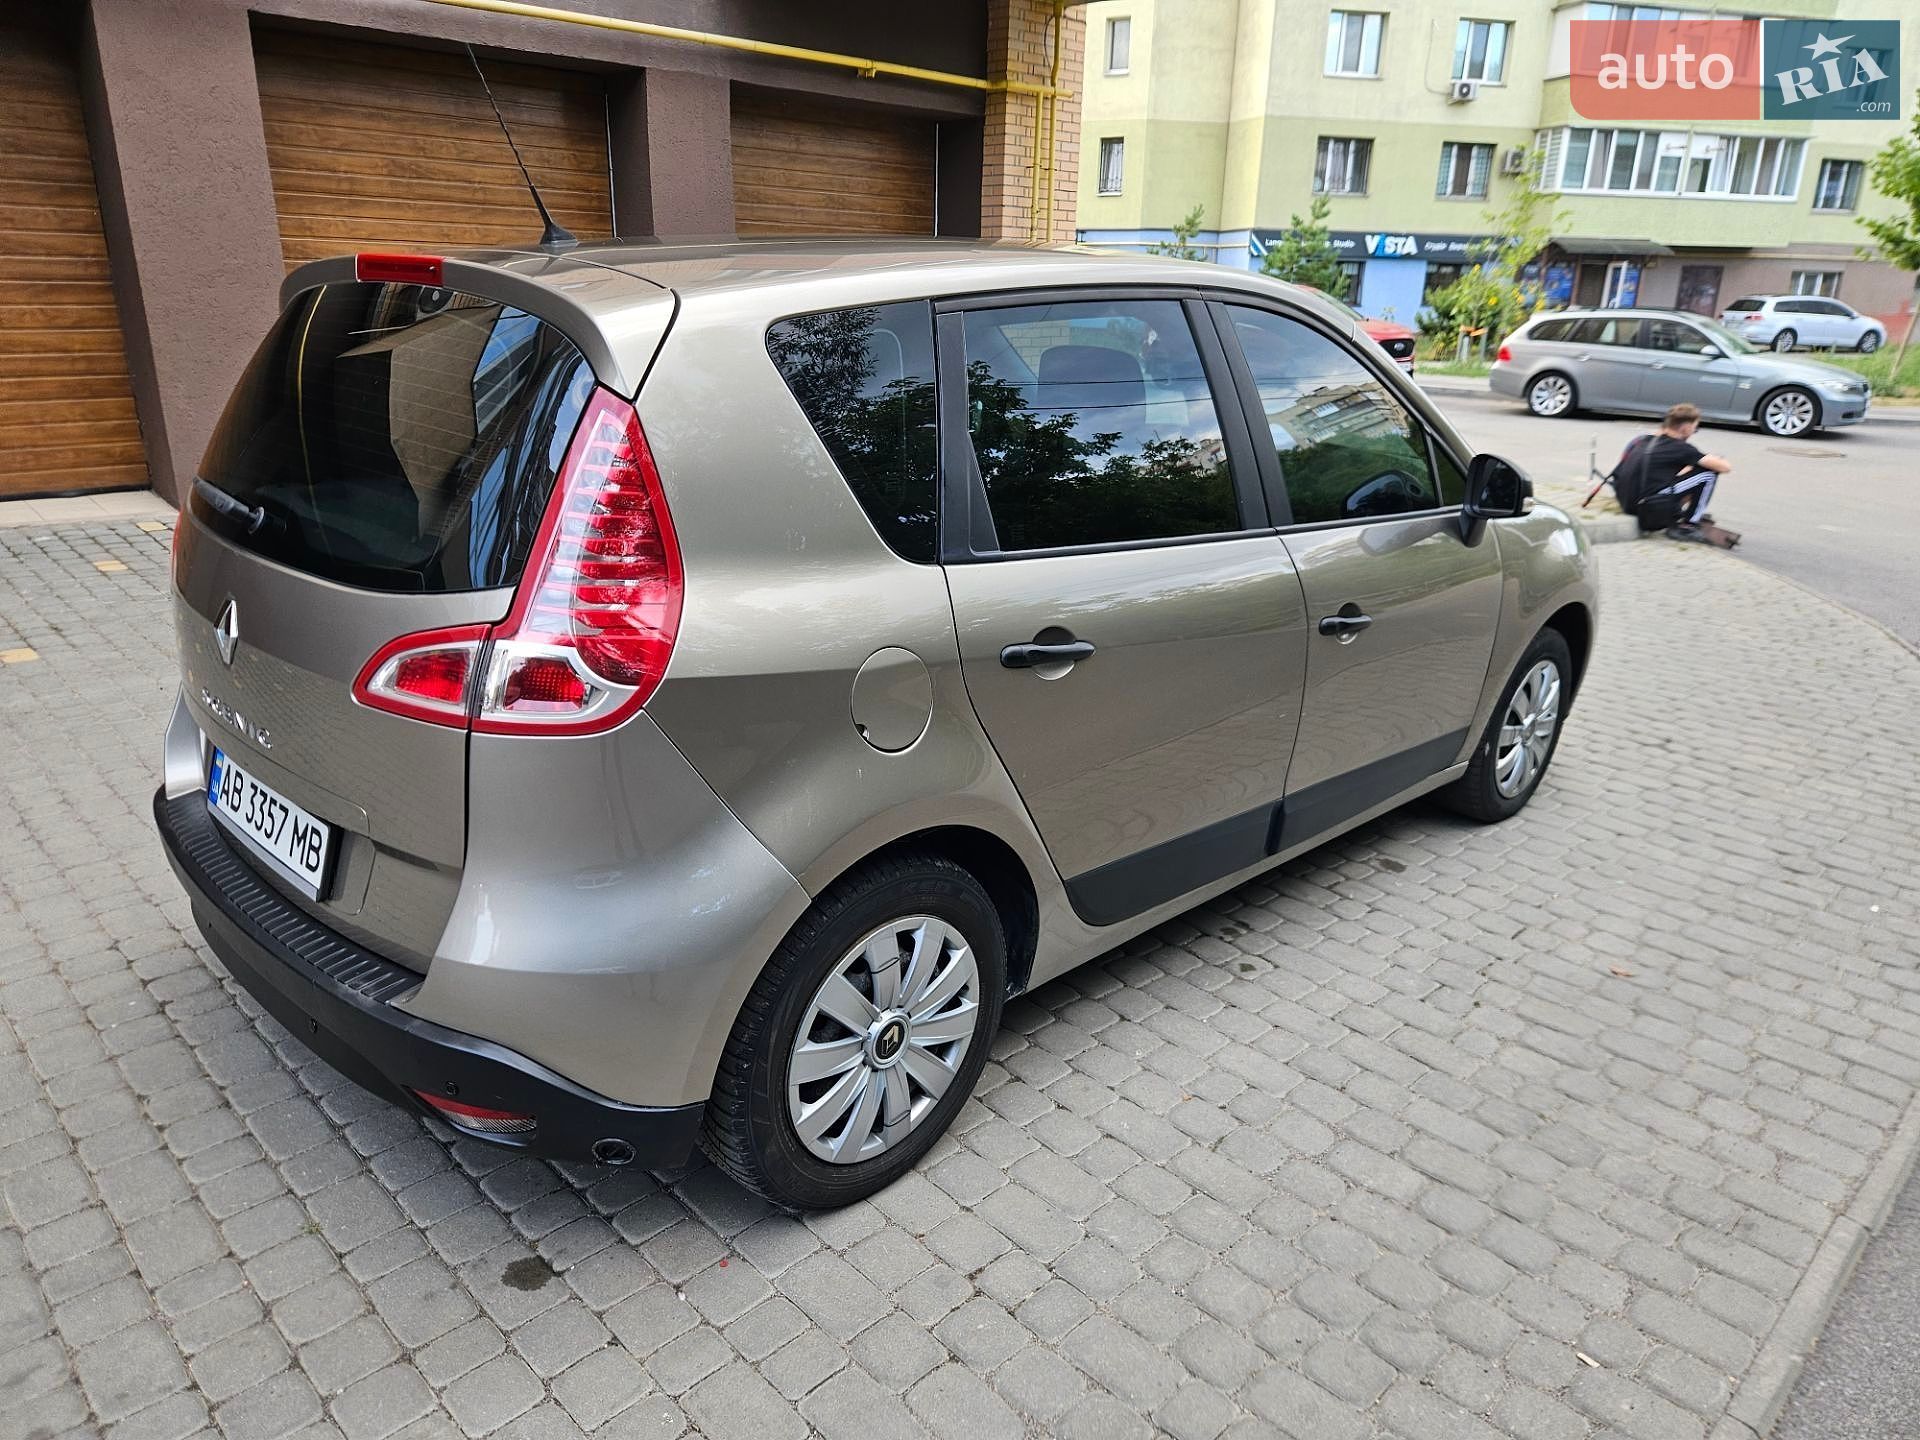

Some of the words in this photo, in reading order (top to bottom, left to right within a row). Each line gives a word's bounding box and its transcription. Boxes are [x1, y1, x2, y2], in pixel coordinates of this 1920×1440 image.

[220, 764, 244, 813] AB
[245, 782, 290, 845] 3357
[289, 815, 323, 873] MB
